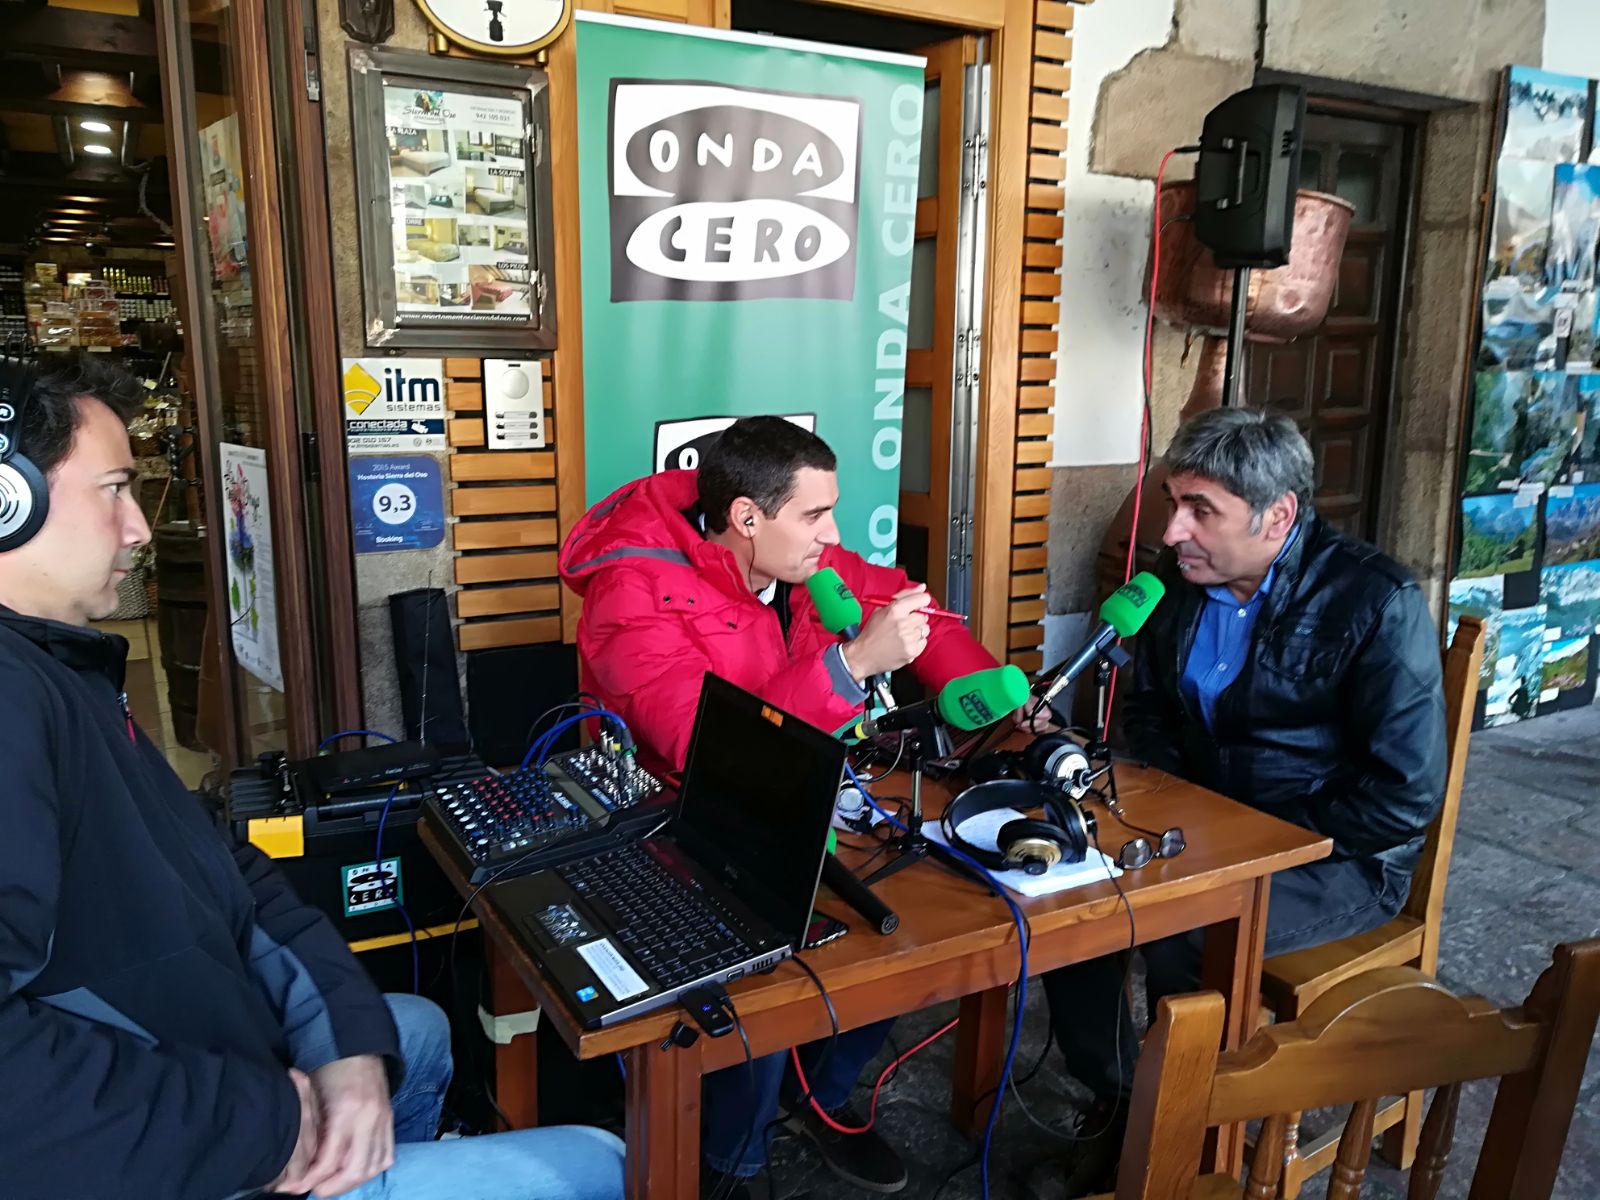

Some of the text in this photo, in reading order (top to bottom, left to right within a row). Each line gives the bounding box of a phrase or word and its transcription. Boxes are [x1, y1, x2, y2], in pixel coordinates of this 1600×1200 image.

[649, 129, 823, 178] ONDA
[659, 215, 822, 263] CERO
[871, 83, 925, 471] ONDA CERO
[384, 367, 440, 402] itm
[386, 402, 441, 412] sistemas
[349, 419, 408, 429] conectada
[390, 463, 411, 471] Award
[379, 494, 412, 513] 9,3
